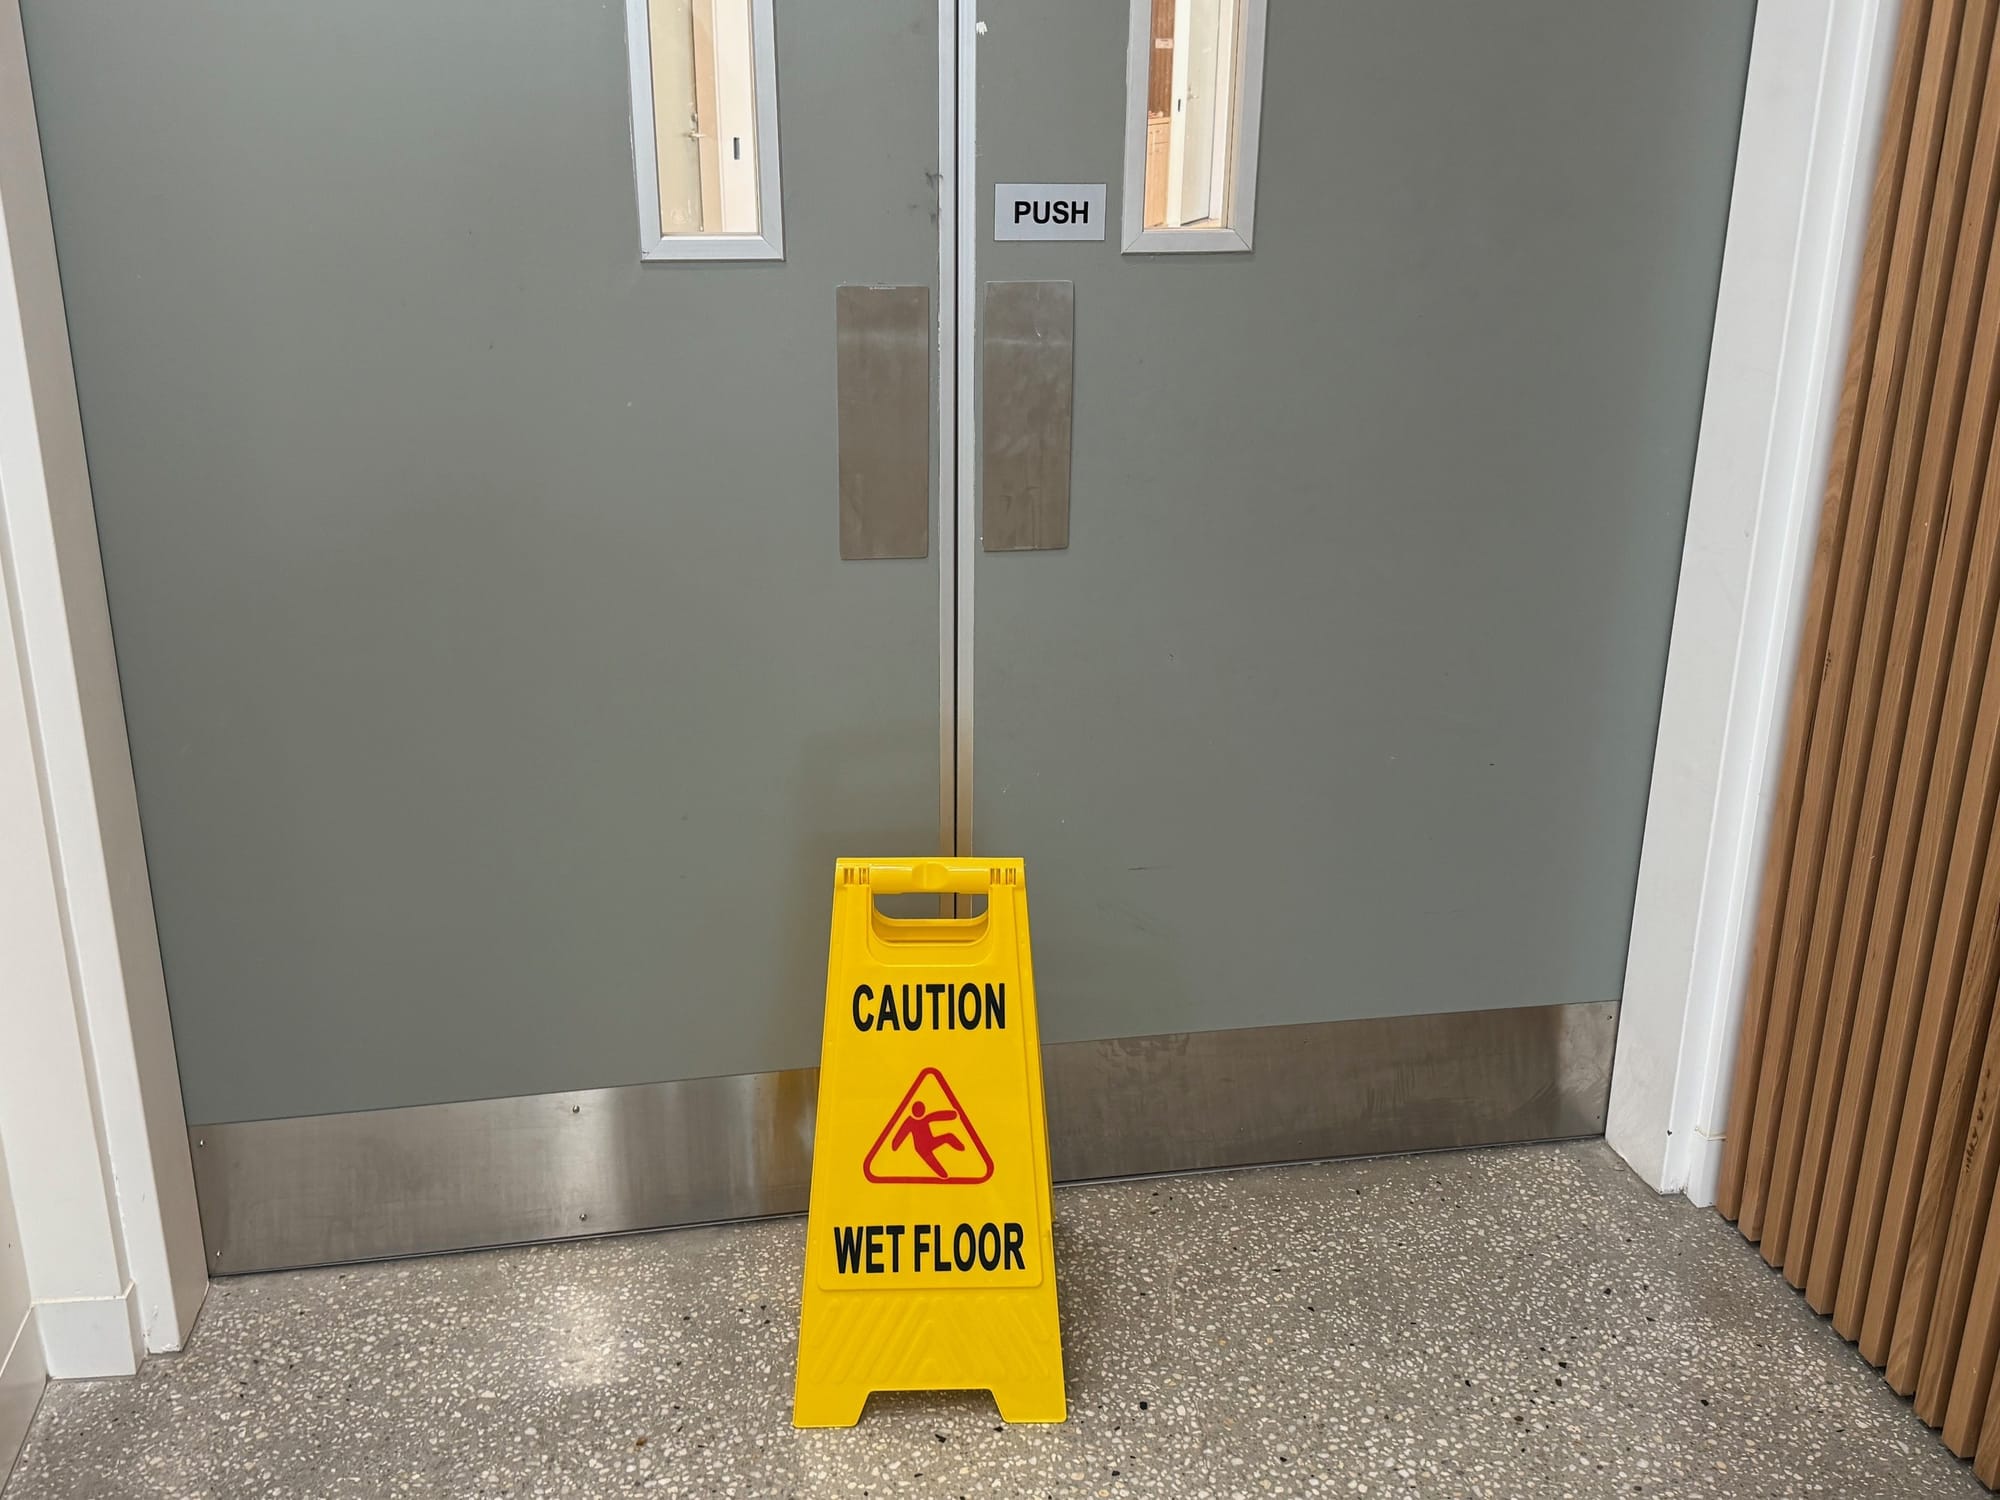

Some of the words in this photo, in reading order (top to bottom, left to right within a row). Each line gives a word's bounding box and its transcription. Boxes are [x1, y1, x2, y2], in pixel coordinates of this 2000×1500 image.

[1014, 200, 1089, 225] PUSH
[852, 982, 1006, 1032] CAUTION
[833, 1224, 906, 1274] WET
[914, 1222, 1026, 1273] FLOOR
